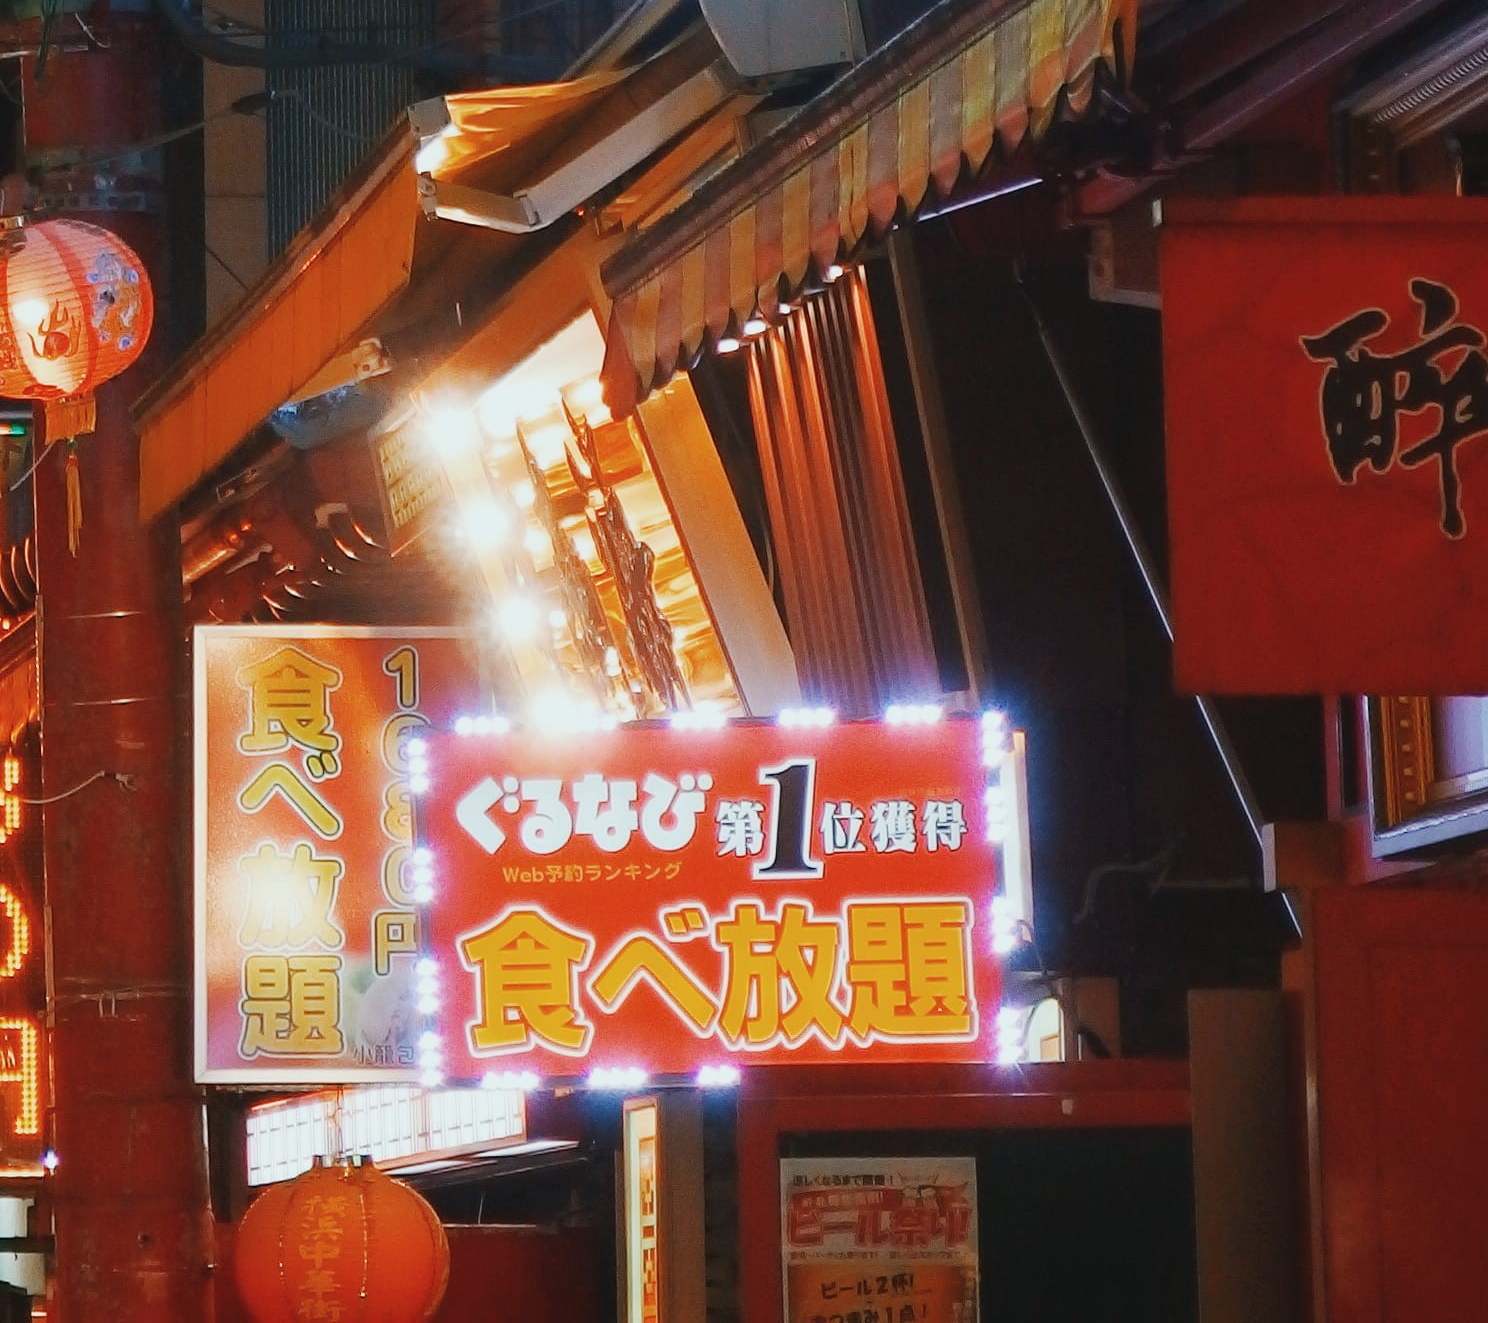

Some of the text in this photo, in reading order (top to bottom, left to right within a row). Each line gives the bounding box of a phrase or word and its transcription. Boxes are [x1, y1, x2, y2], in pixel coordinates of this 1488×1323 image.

[236, 645, 344, 1056] 食べ放題
[455, 758, 969, 880] ぐるなび 第1位獲得
[502, 861, 683, 883] Web予約ランキング
[460, 901, 976, 1054] 食べ放題
